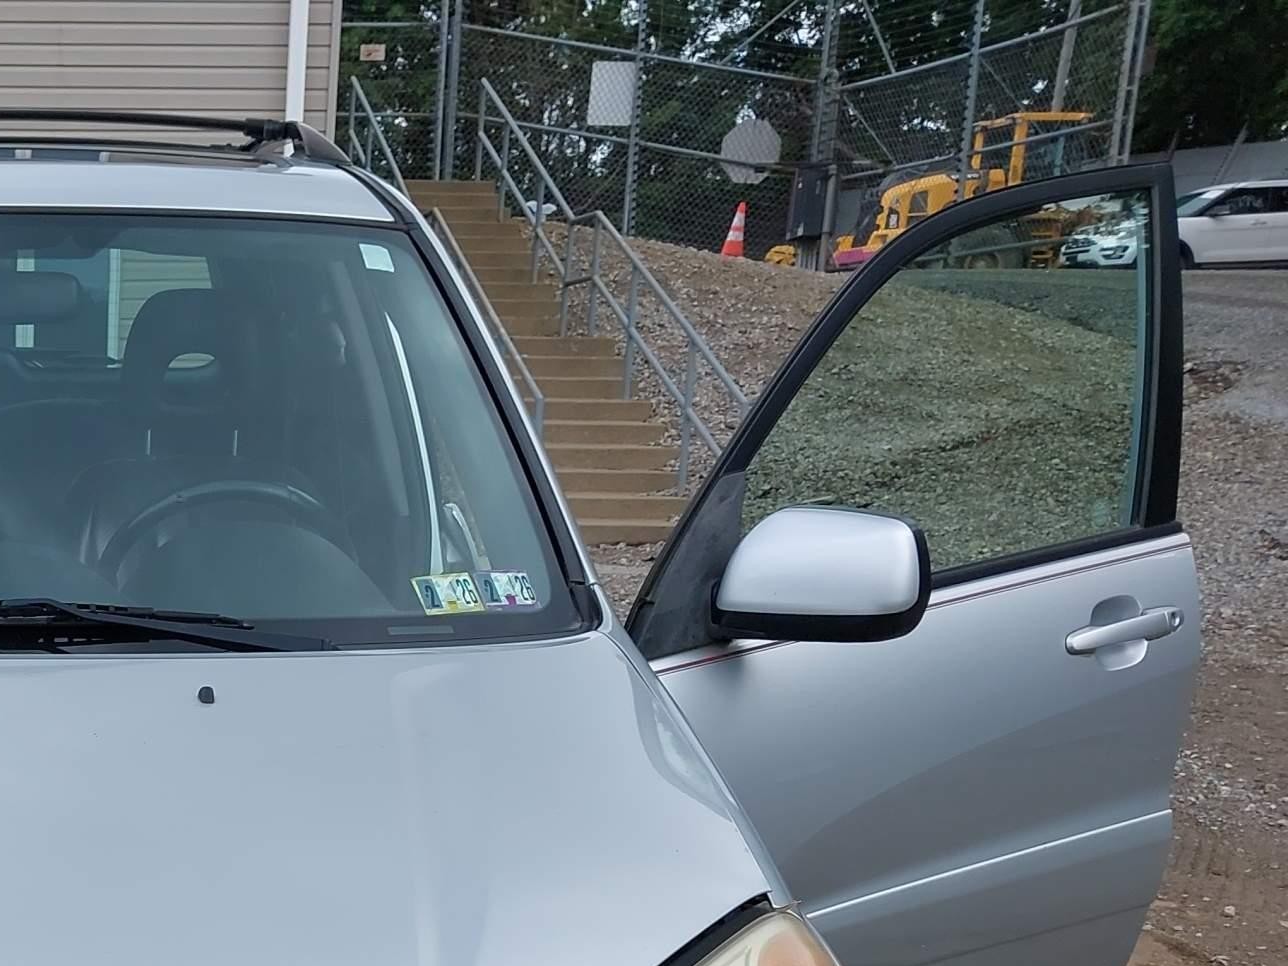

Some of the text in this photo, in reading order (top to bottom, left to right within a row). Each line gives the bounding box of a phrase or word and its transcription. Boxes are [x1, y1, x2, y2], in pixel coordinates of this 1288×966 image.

[425, 578, 479, 608] 2 26
[484, 575, 536, 603] 2 26
